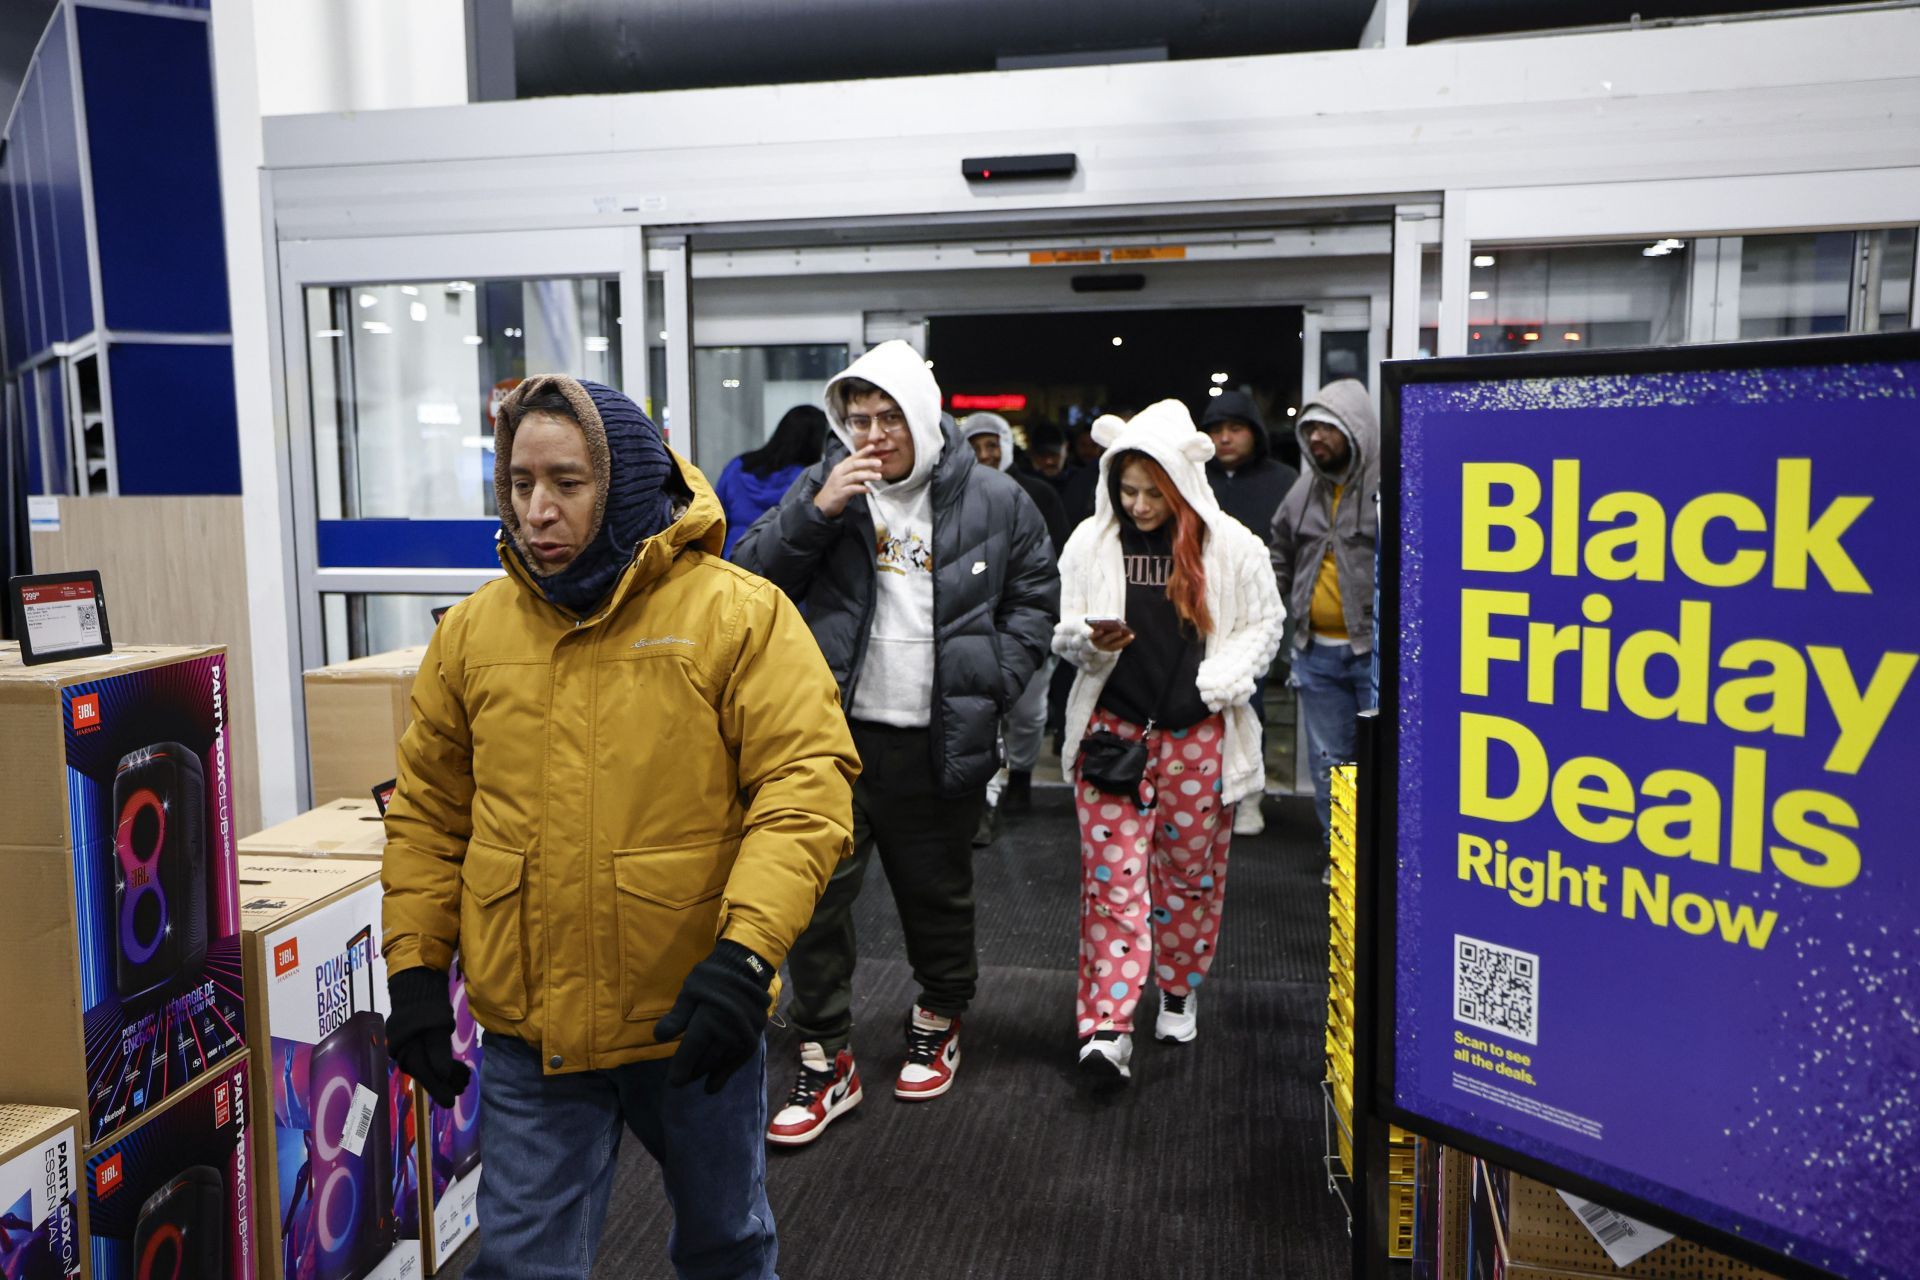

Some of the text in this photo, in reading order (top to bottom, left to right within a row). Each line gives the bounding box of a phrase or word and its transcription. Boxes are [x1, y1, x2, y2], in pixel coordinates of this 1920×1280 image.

[1461, 457, 1875, 594] Black
[1460, 588, 1920, 775] Friday
[78, 703, 96, 720] JBL
[1459, 711, 1863, 888] Deals
[131, 865, 150, 889] JBL
[1457, 832, 1779, 950] Right Now
[279, 947, 294, 966] JBL
[316, 936, 379, 992] POWERFUL
[204, 979, 215, 997] DE
[317, 979, 348, 1018] BASS
[122, 1022, 137, 1039] PURE
[319, 1003, 348, 1038] BOOST
[1454, 1030, 1532, 1066] Scan to see
[1454, 1049, 1537, 1086] all the deals.
[101, 1165, 119, 1185] JBL
[45, 1148, 58, 1252] ESSENTIAL
